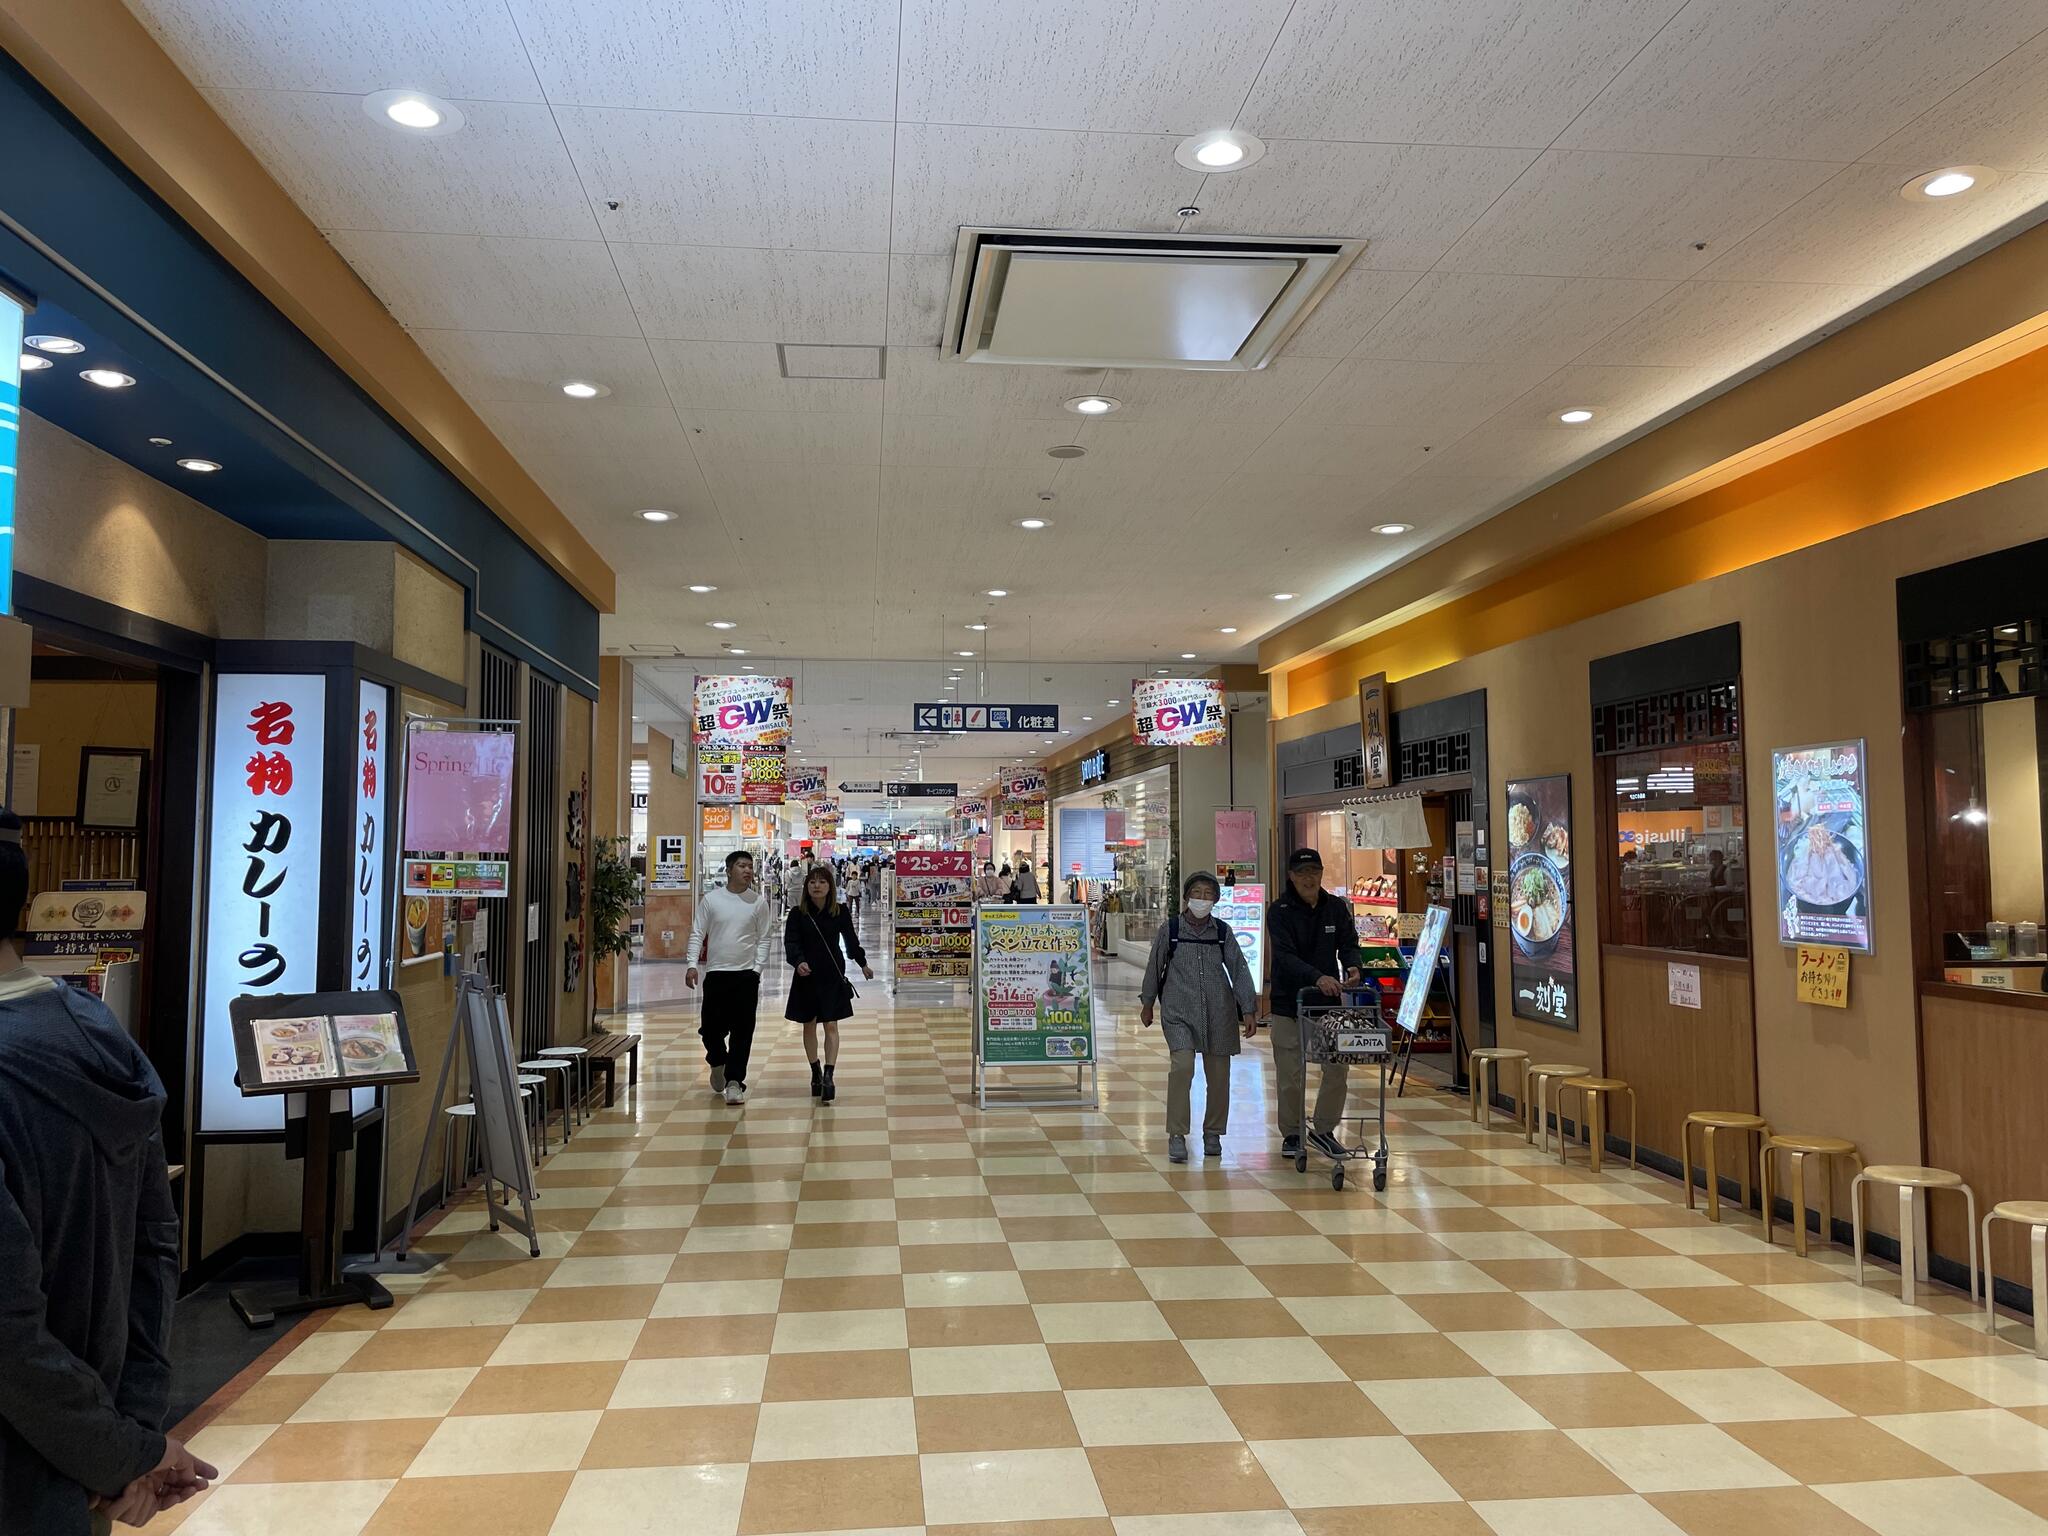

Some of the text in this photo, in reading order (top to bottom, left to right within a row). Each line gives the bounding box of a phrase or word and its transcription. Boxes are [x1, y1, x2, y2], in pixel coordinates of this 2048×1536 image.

[1018, 715, 1055, 729] 化粧室
[414, 751, 472, 777] Spring
[704, 814, 730, 824] SHOP
[862, 823, 901, 835] Foods
[238, 700, 295, 990] 名物カレーう
[357, 707, 379, 991] 名物カレーう
[991, 936, 1078, 951] ペン立てを作ろう
[1800, 950, 1836, 969] ラーメン
[1519, 981, 1567, 1019] 一刻堂
